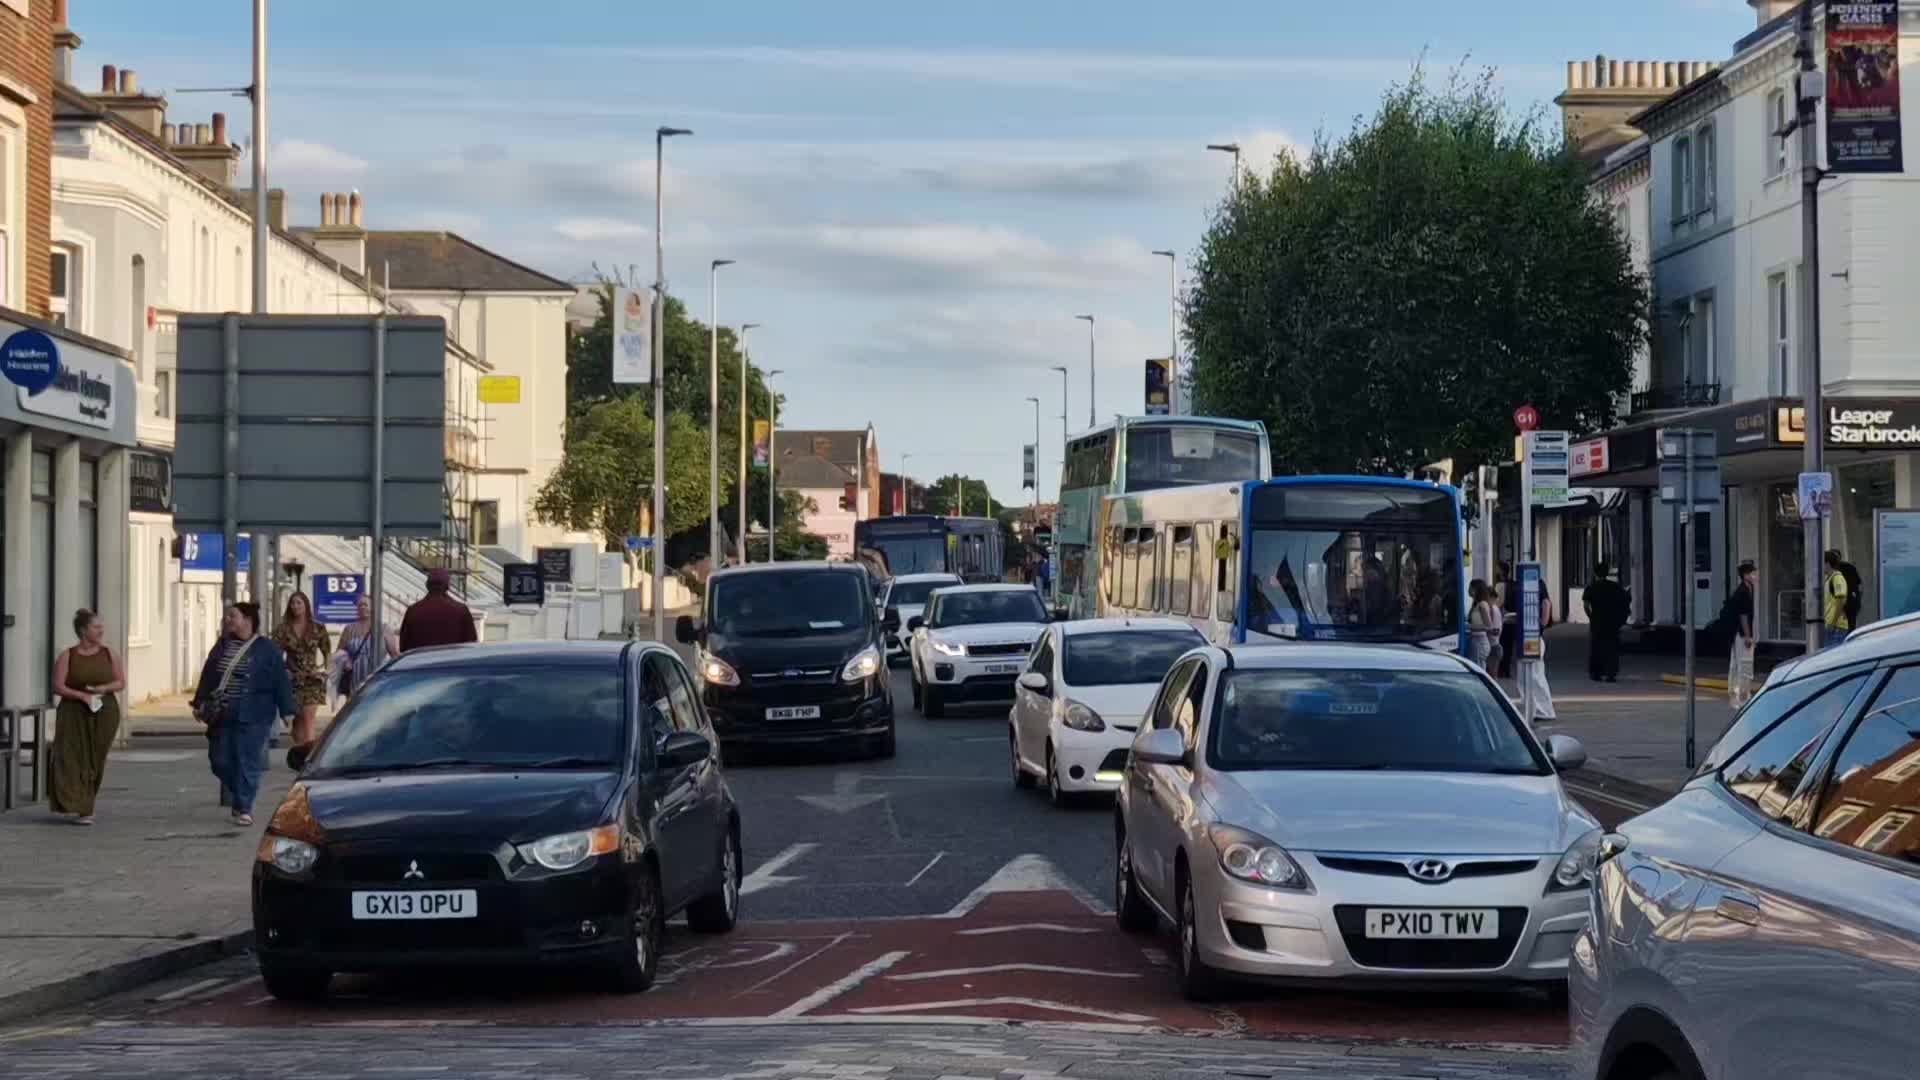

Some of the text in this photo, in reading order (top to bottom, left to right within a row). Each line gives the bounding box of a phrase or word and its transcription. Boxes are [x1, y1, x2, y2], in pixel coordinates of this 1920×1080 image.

[1828, 3, 1896, 14] JOHNNY
[1840, 14, 1884, 25] CASH
[1830, 406, 1894, 427] Leaper
[365, 893, 464, 915] GX13 OPU
[1380, 912, 1485, 935] PX10 TWV
